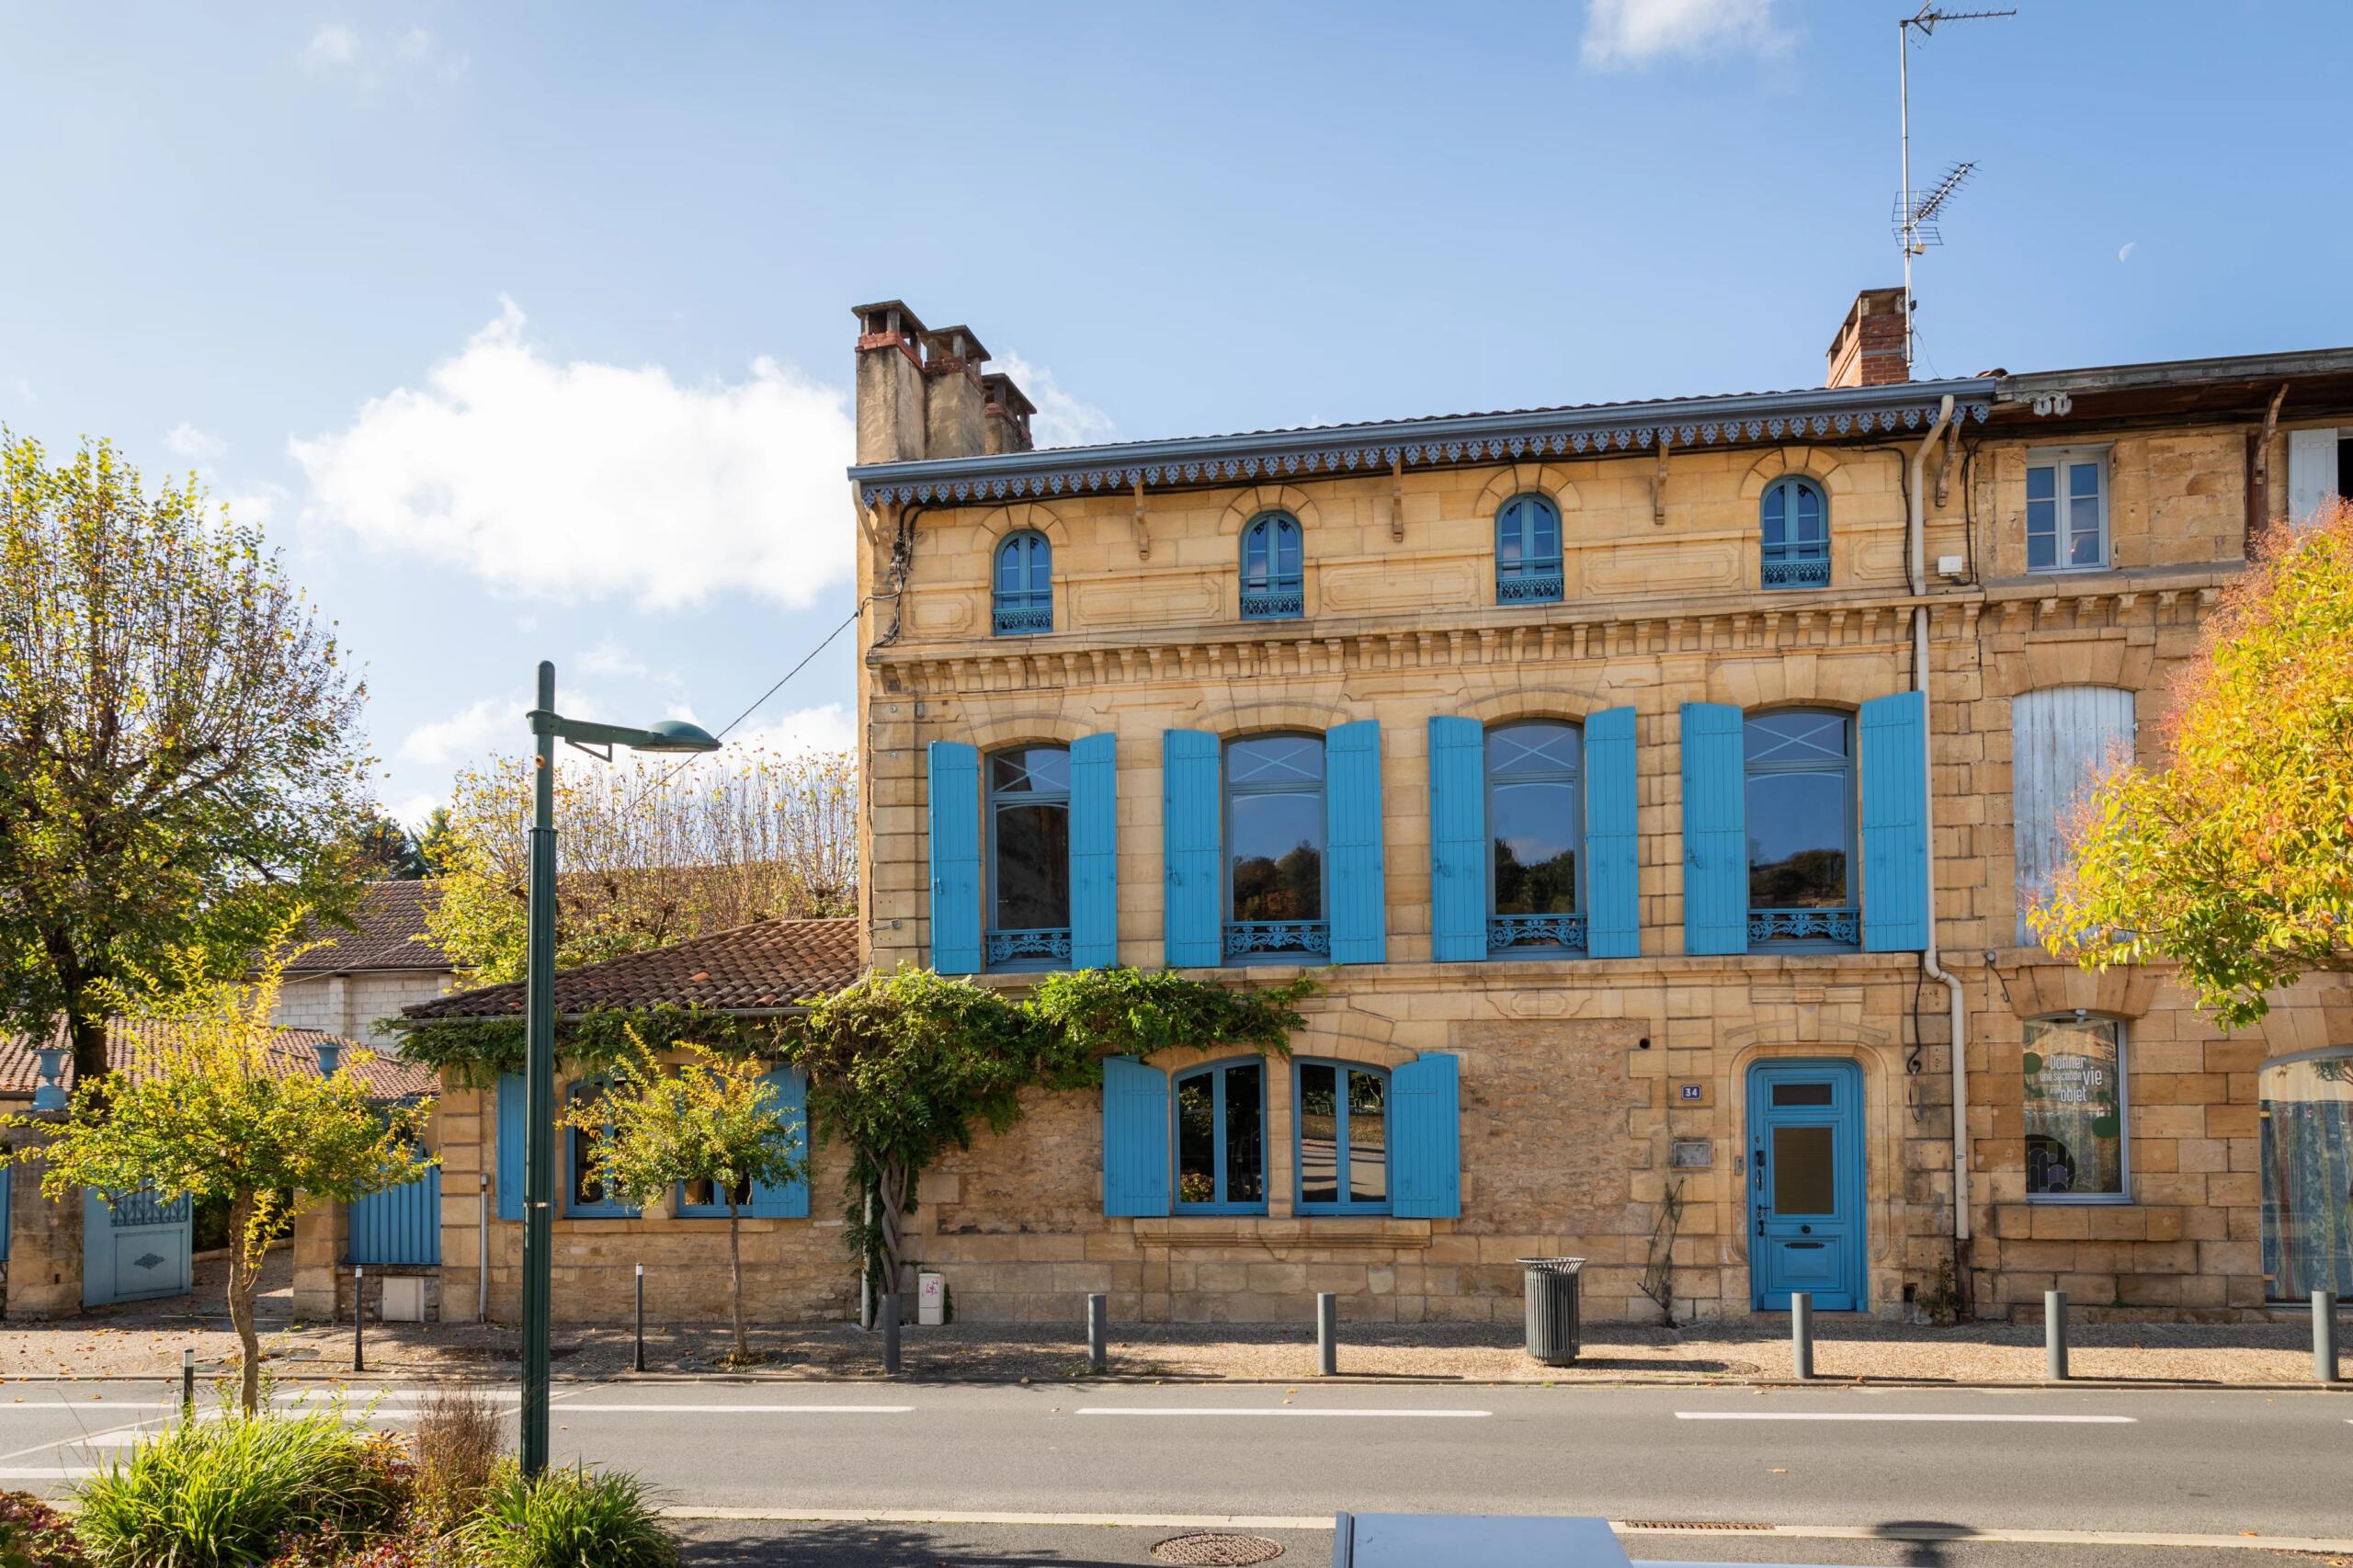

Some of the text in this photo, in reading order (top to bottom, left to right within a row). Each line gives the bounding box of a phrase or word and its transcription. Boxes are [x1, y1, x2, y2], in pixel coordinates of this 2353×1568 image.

[2050, 1054, 2086, 1070] Donner
[2040, 1066, 2102, 1085] une seconde vie
[1685, 1087, 1698, 1096] 34
[2061, 1085, 2087, 1103] objet
